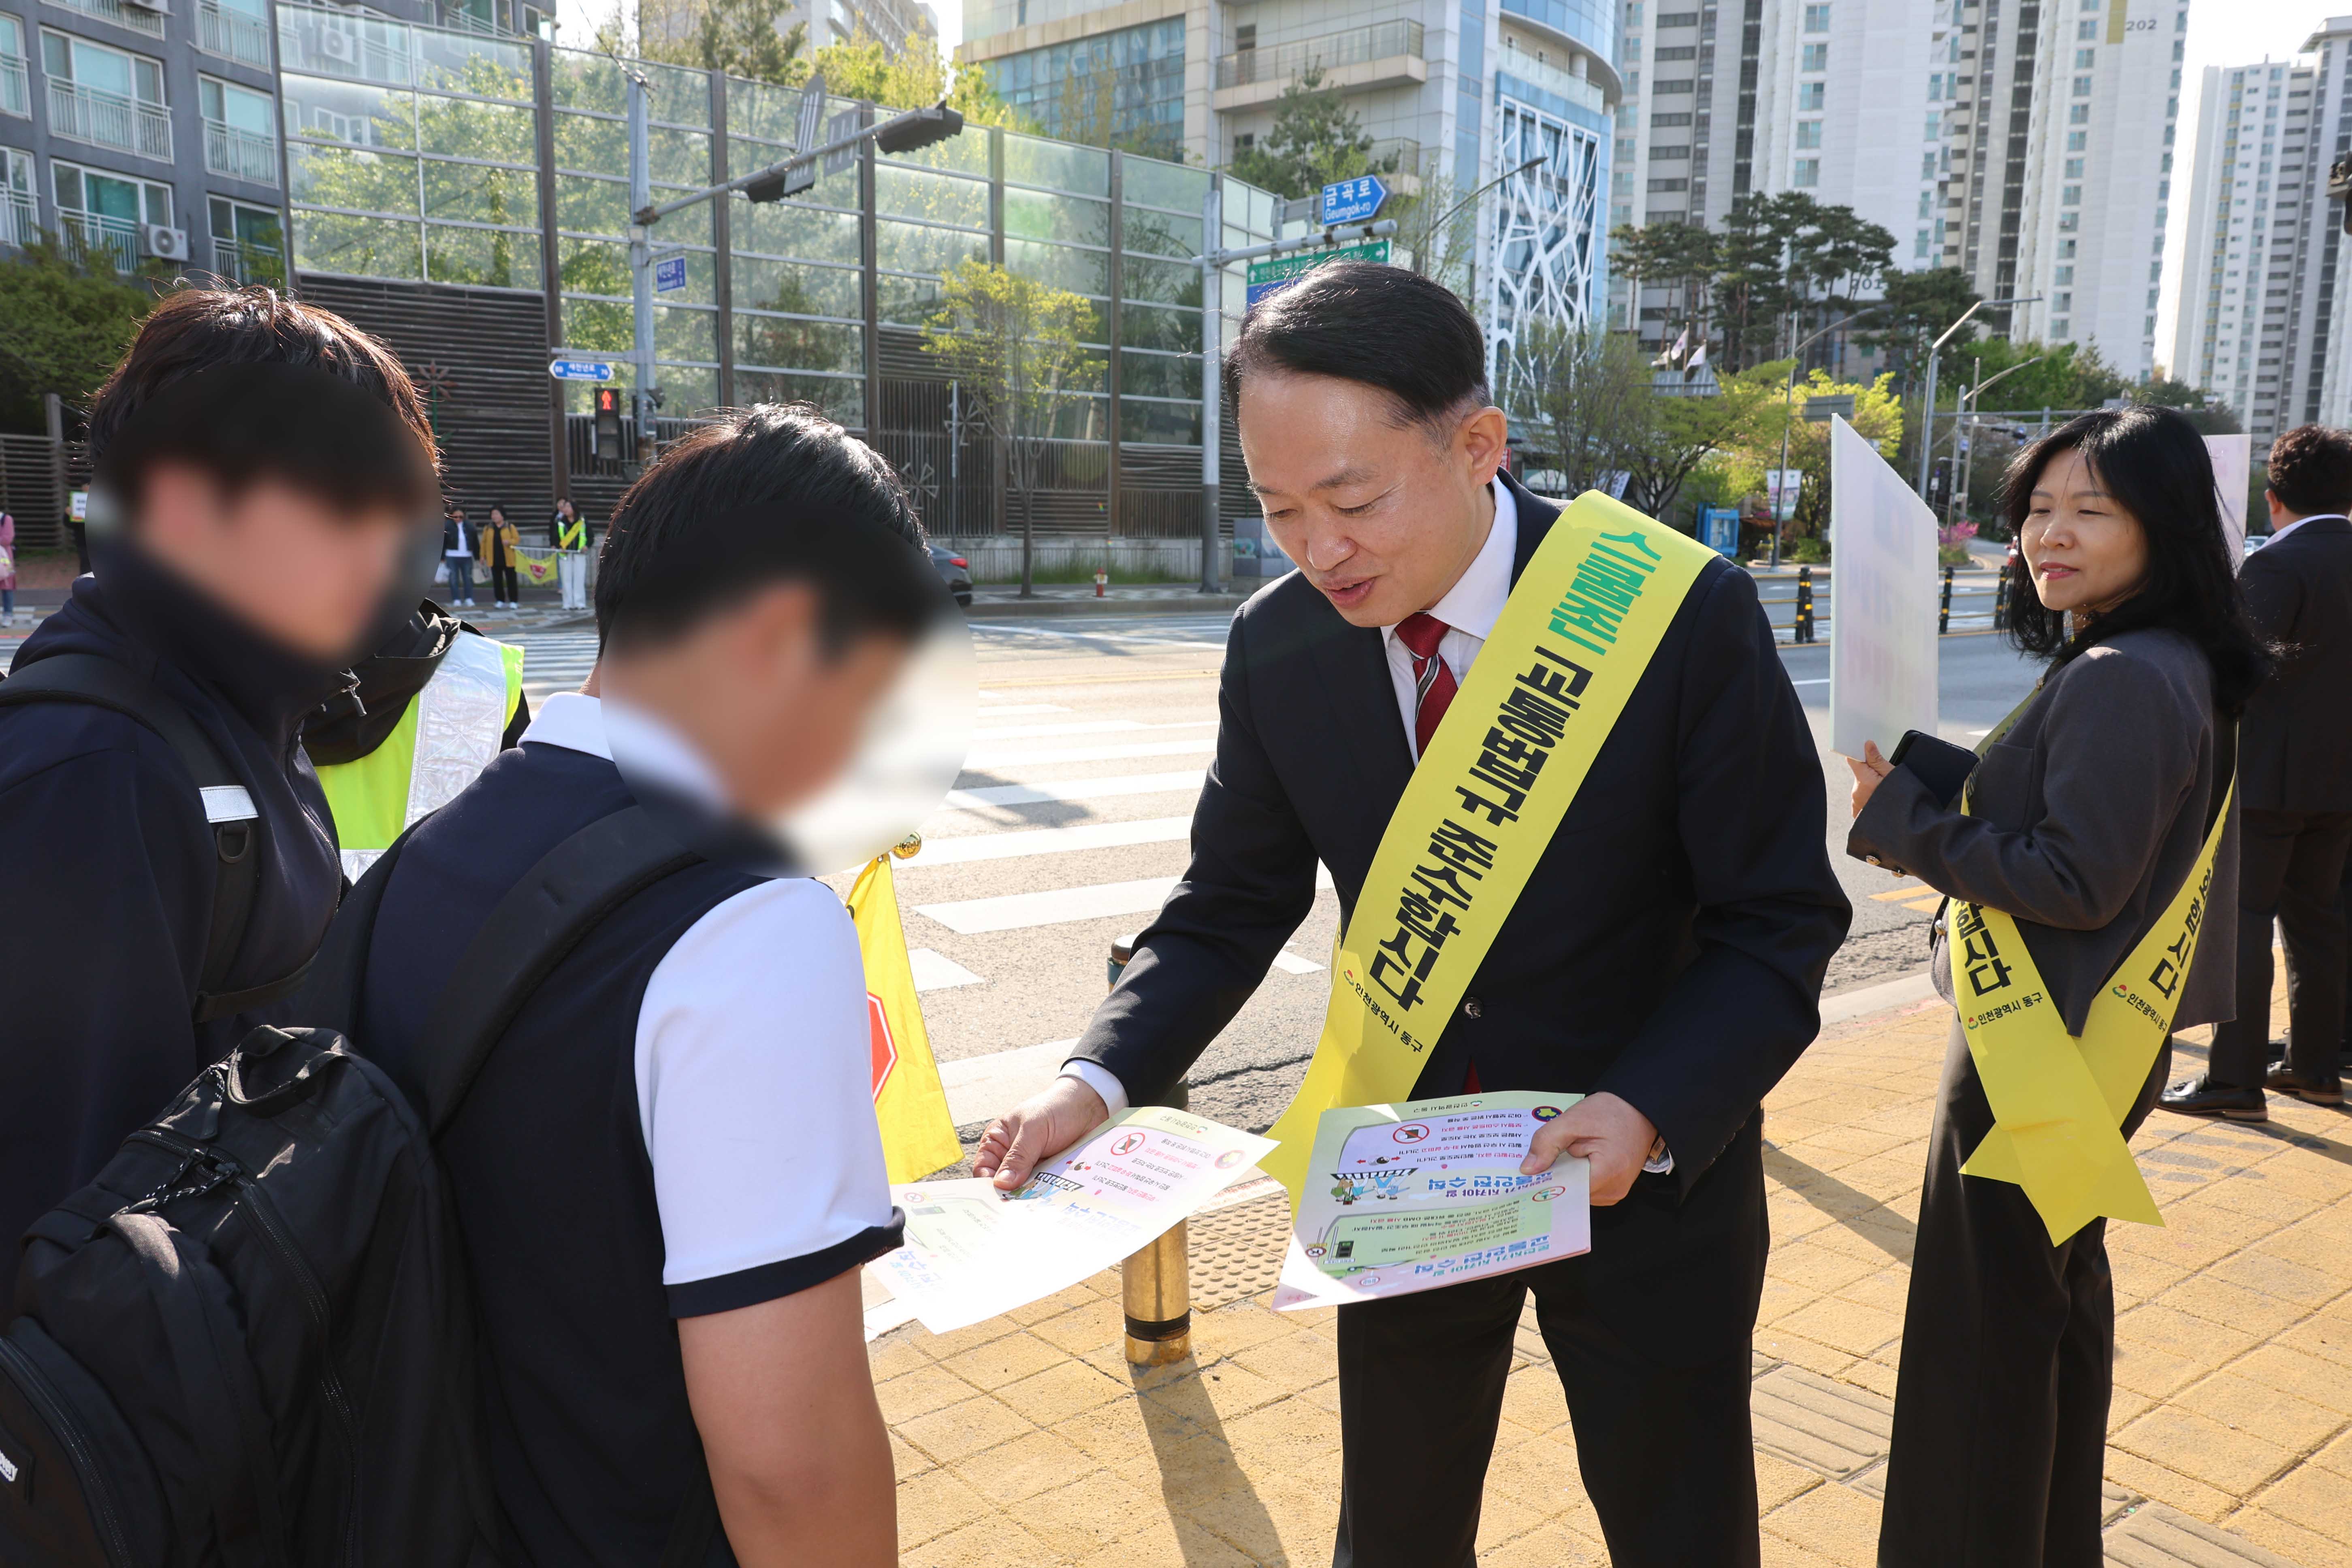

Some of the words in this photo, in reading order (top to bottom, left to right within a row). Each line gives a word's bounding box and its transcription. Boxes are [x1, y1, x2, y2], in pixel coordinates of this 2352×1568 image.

[2126, 19, 2157, 31] 202
[1325, 179, 1371, 207] 금곡로
[1325, 202, 1371, 220] Geumgok-ro
[1546, 530, 1663, 656] 스쿨존
[1454, 644, 1594, 827] 교통법규
[1369, 817, 1497, 1013] 준수합시다
[1954, 898, 2012, 997] 합시다
[1977, 1000, 2021, 1025] 인천광역시
[2022, 992, 2043, 1008] 동구
[2127, 992, 2159, 1024] 인천광역시
[1355, 982, 1399, 1035] 인천광역시
[1400, 1030, 1423, 1053] 동구
[1170, 1118, 1198, 1130] 인천광역시
[1094, 1160, 1111, 1168] 건너기
[1131, 1157, 1147, 1166] 차도로
[1153, 1166, 1171, 1175] 보도로
[1166, 1170, 1184, 1181] 사람은
[1427, 1176, 1467, 1191] 수칙
[1445, 1190, 1457, 1198] 할
[1461, 1188, 1499, 1197] 지켜야
